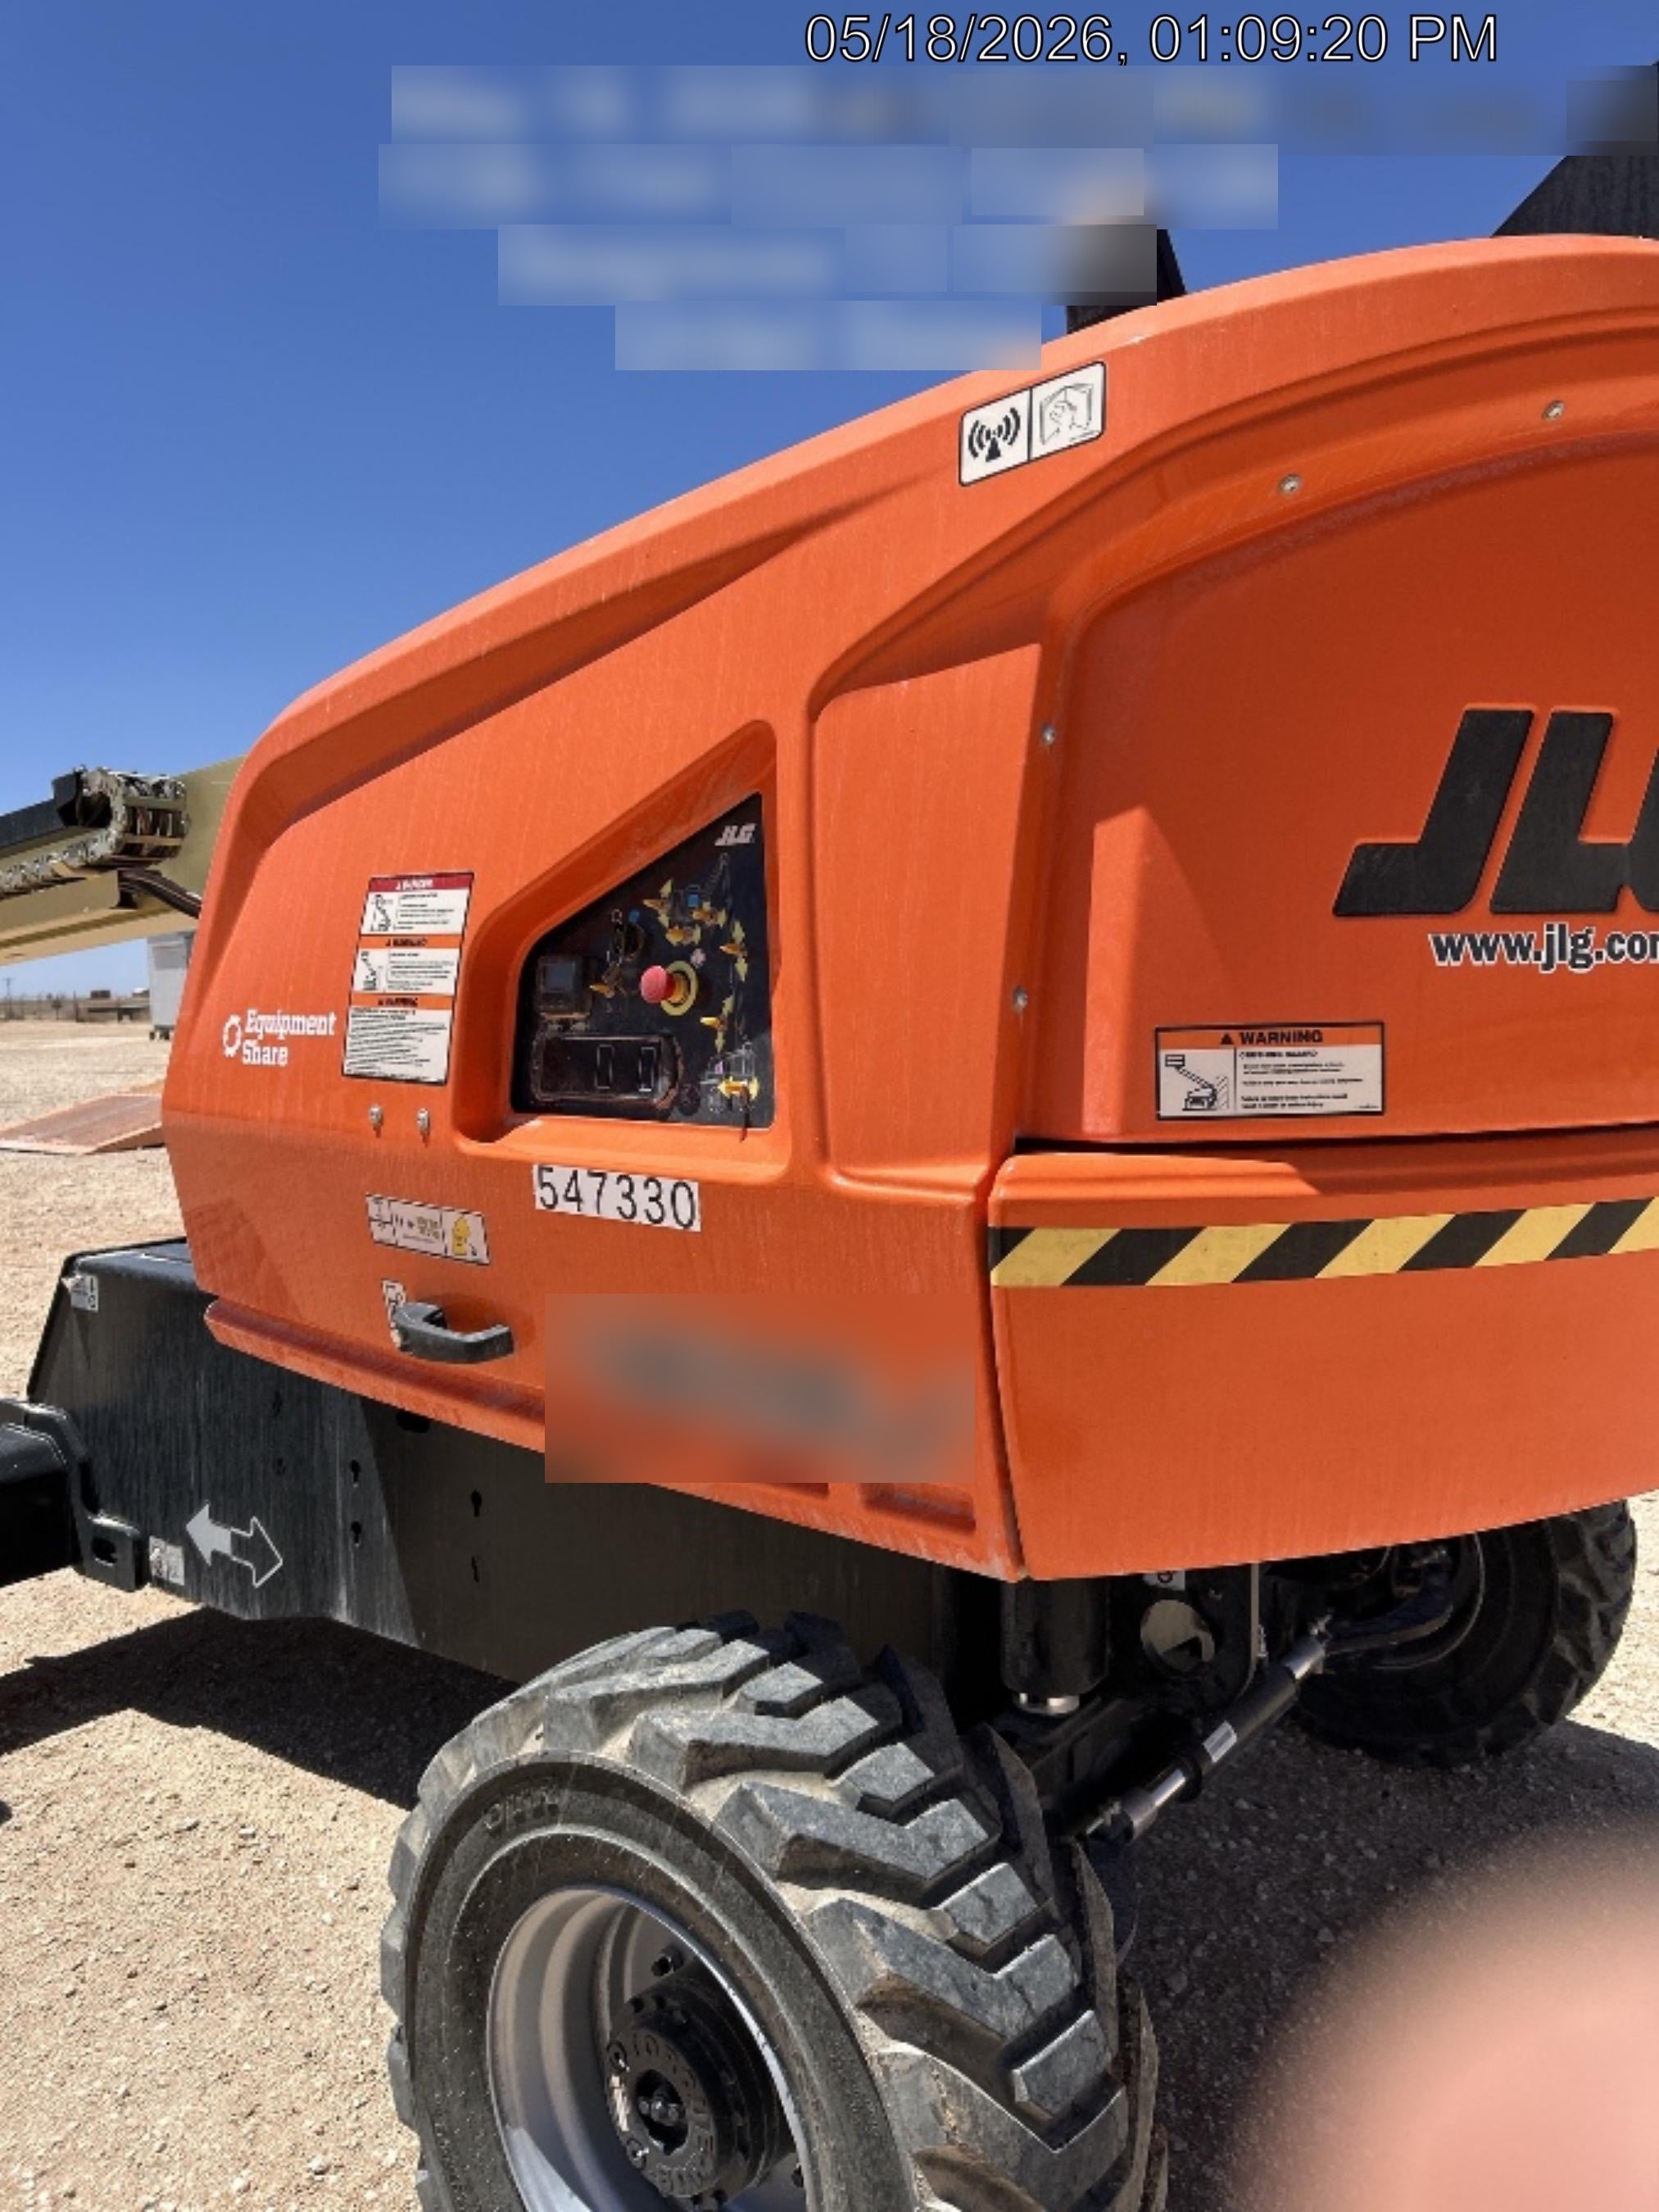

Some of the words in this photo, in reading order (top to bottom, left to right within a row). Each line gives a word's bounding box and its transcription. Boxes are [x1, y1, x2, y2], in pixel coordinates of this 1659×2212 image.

[1332, 708, 1659, 917] JL
[246, 1009, 337, 1040] Equipment
[1239, 1029, 1324, 1045] WARNING
[243, 1038, 288, 1067] Share
[537, 1166, 696, 1228] 547330
